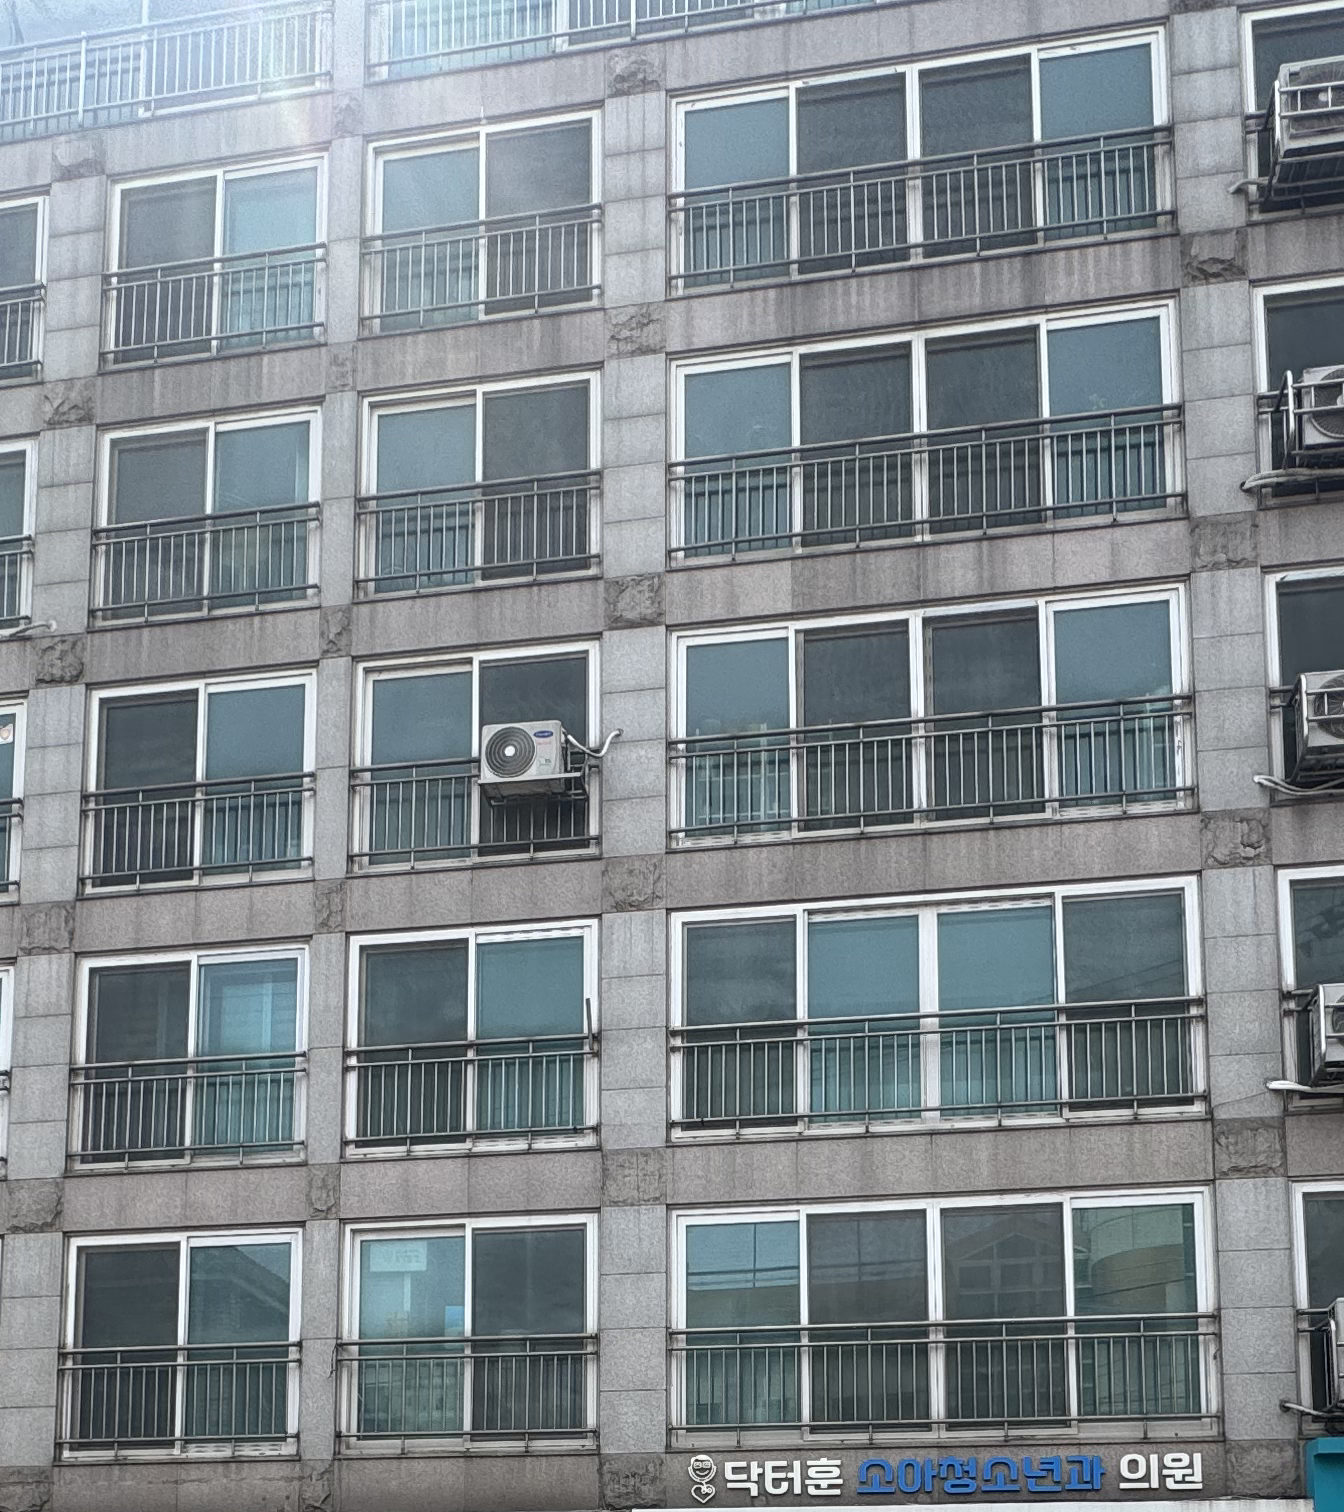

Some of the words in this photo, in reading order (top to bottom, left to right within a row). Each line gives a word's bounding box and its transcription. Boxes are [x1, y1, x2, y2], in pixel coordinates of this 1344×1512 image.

[724, 1458, 844, 1497] 닥터훈
[857, 1455, 1106, 1494] 소아청소년과
[1119, 1452, 1204, 1490] 의원
